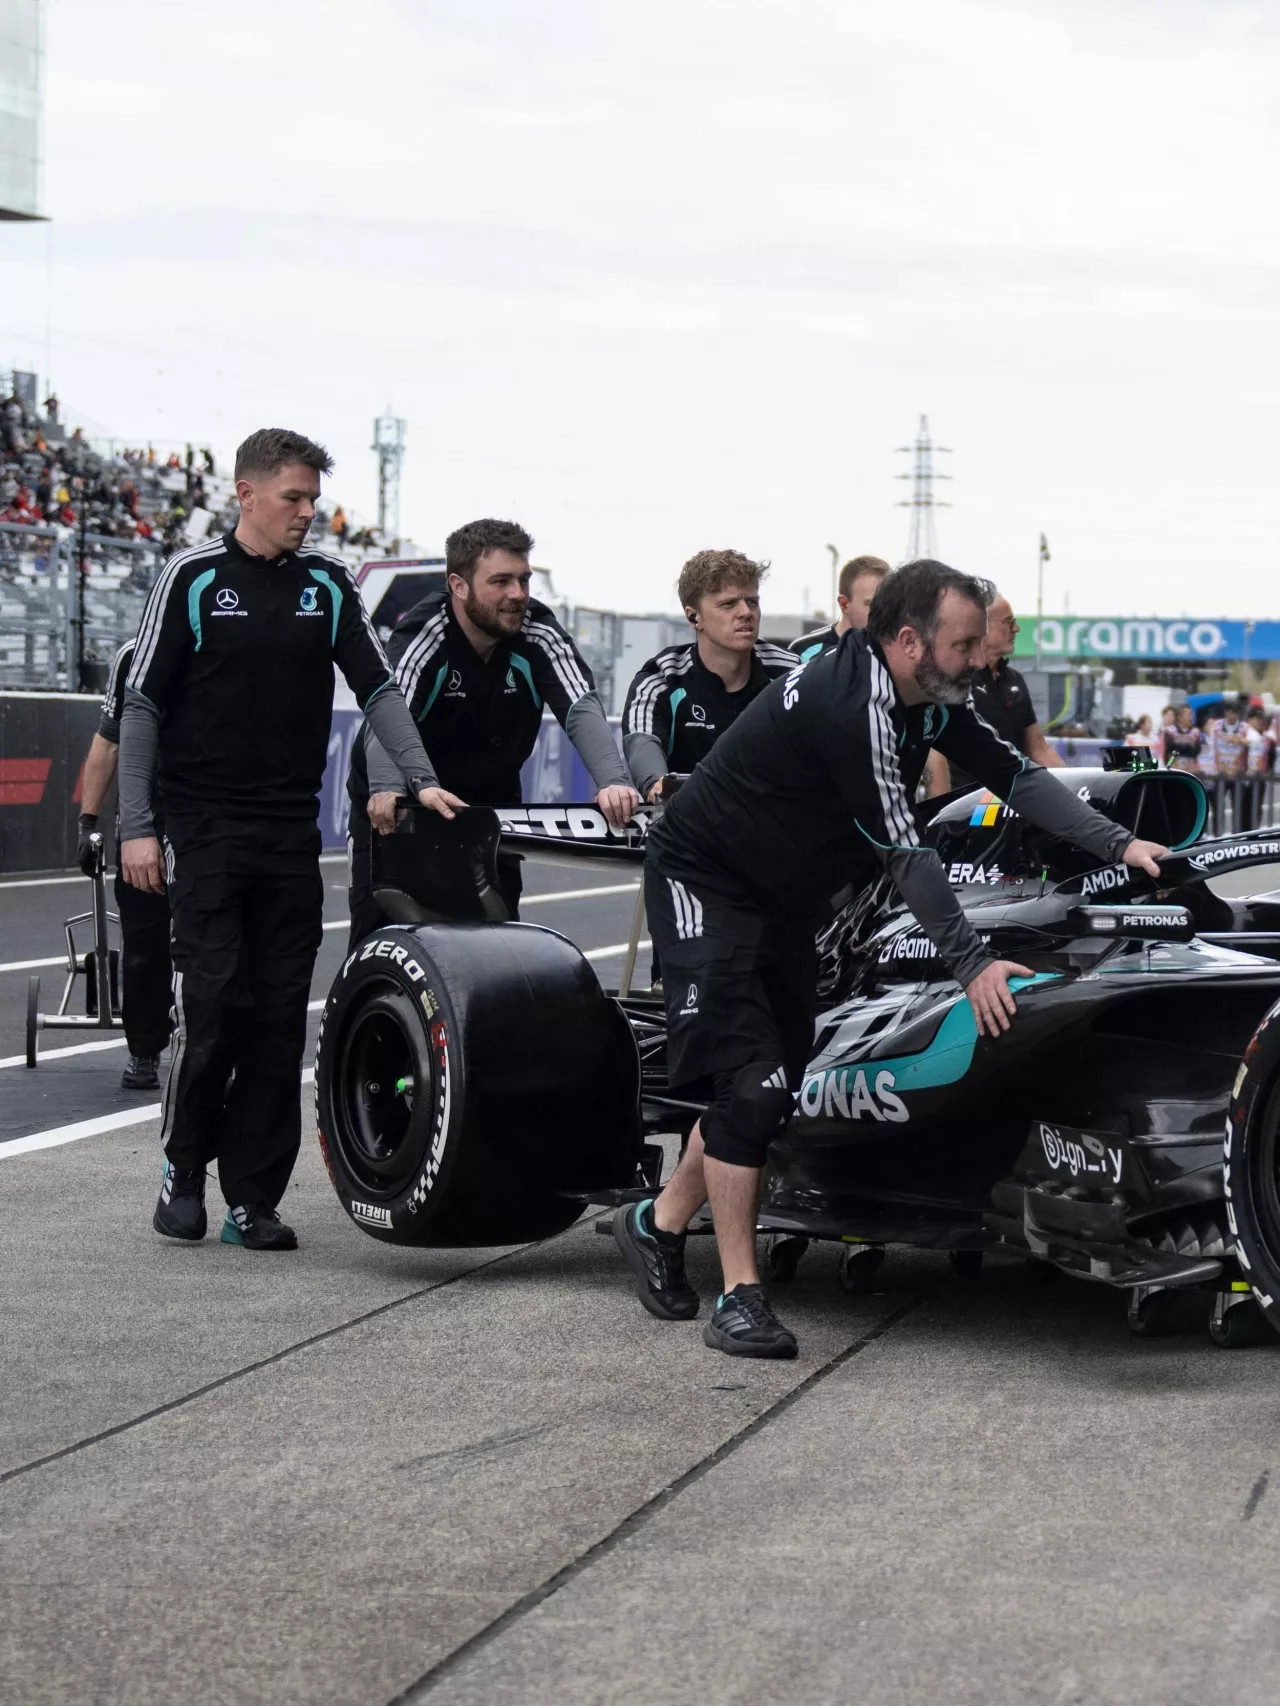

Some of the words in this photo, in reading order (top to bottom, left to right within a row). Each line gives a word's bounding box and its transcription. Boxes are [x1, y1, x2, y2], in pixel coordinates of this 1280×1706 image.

[1032, 620, 1222, 656] aramco
[941, 863, 986, 884] ERA
[1080, 868, 1117, 897] AMD
[1122, 915, 1188, 926] PETRONAS
[342, 951, 357, 979] P
[360, 940, 426, 982] ZERO
[792, 1070, 910, 1123] ONAS
[351, 1200, 394, 1229] PIRELLI
